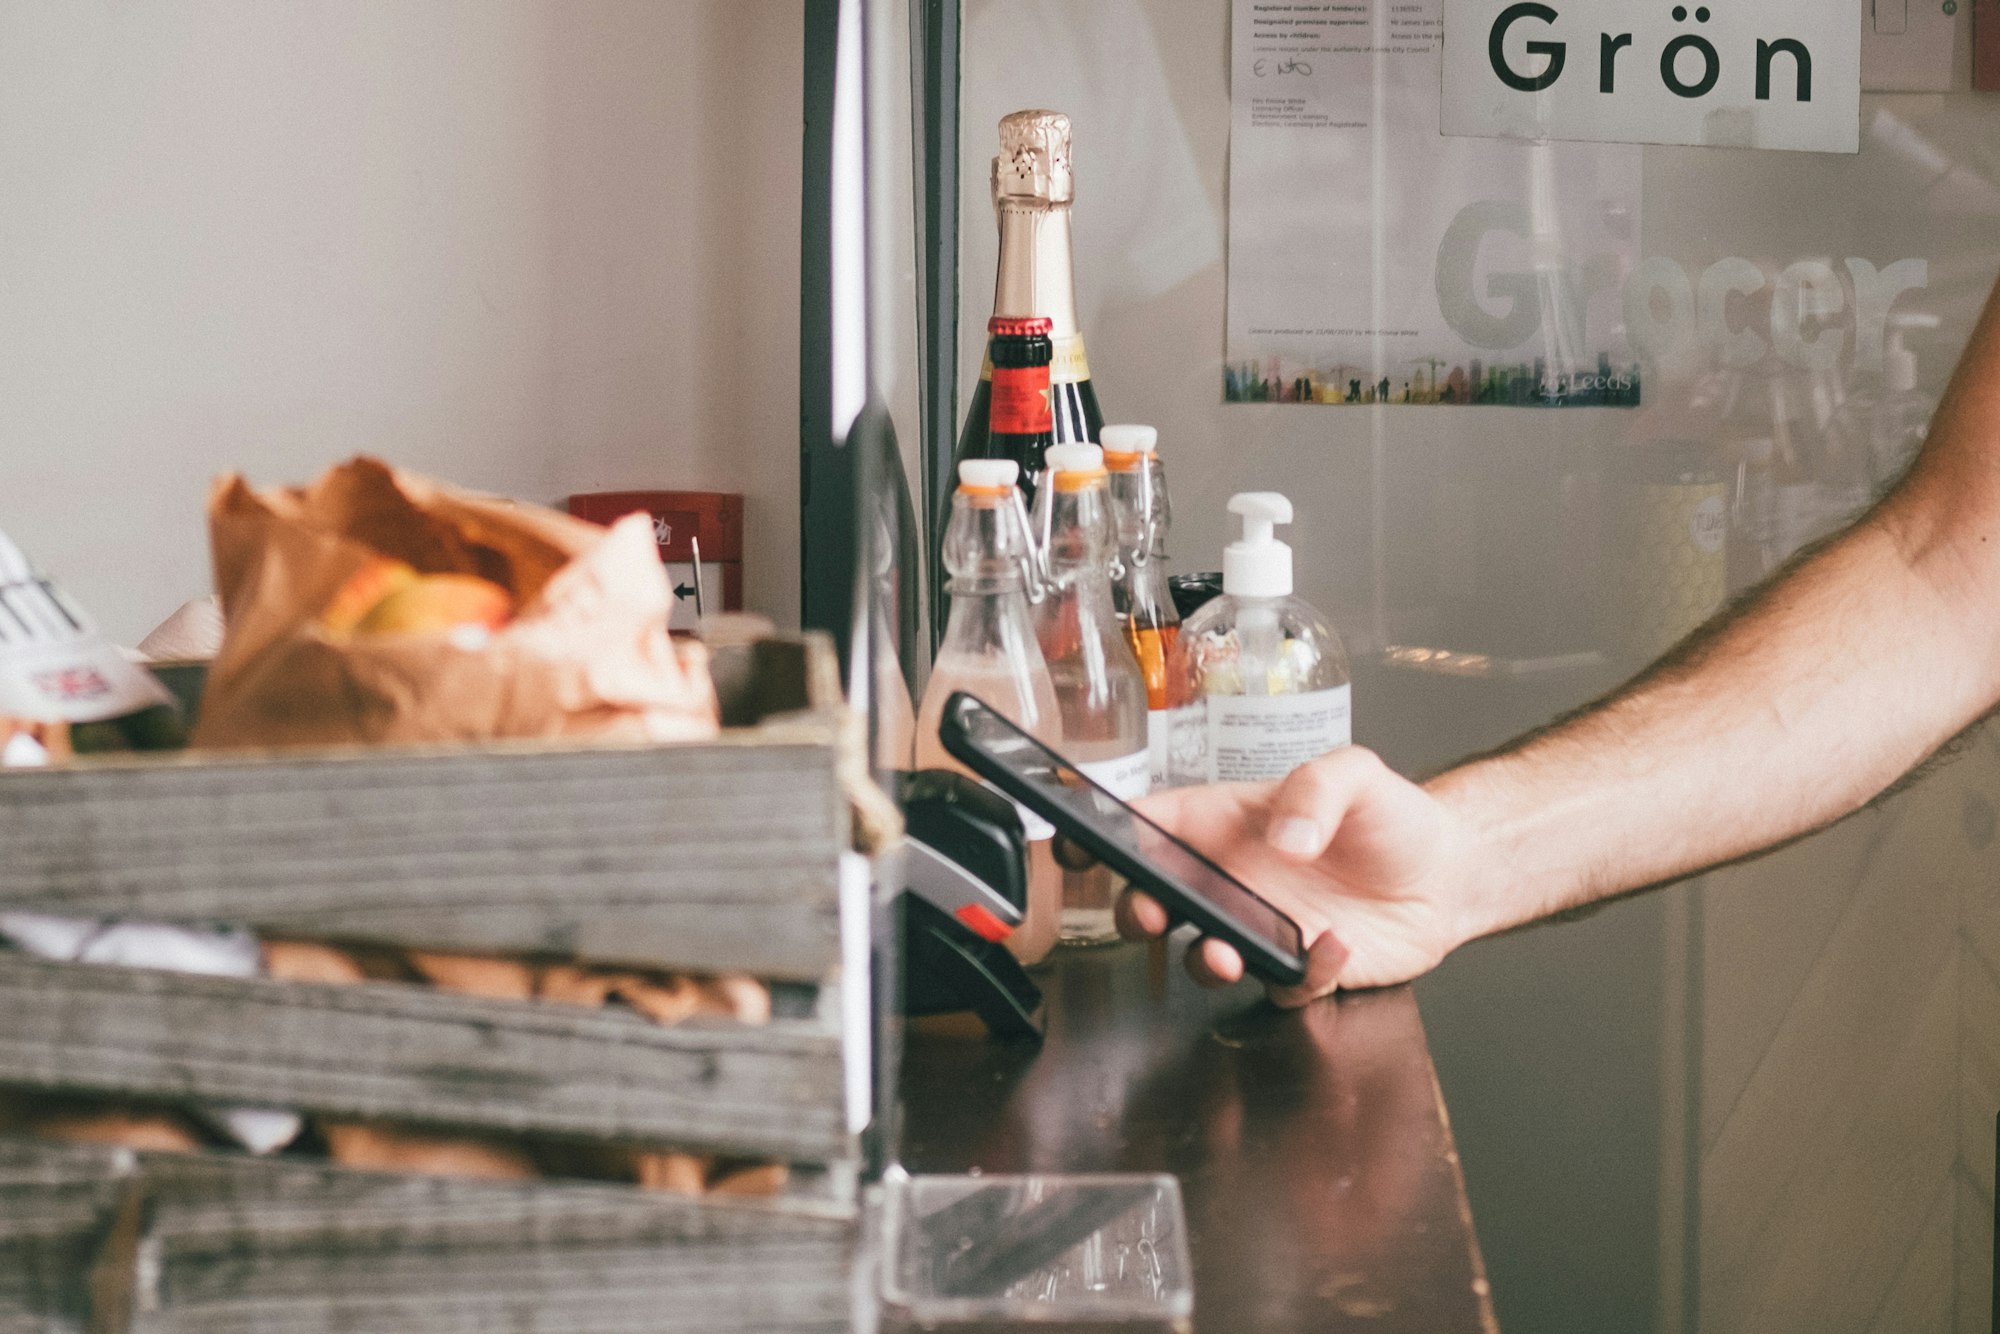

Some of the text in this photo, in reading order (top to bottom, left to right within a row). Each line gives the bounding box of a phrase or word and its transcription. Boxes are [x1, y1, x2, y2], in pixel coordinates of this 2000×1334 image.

[1488, 2, 1812, 102] Grön
[1436, 200, 1928, 372] Grocer
[1570, 373, 1632, 391] Leeds
